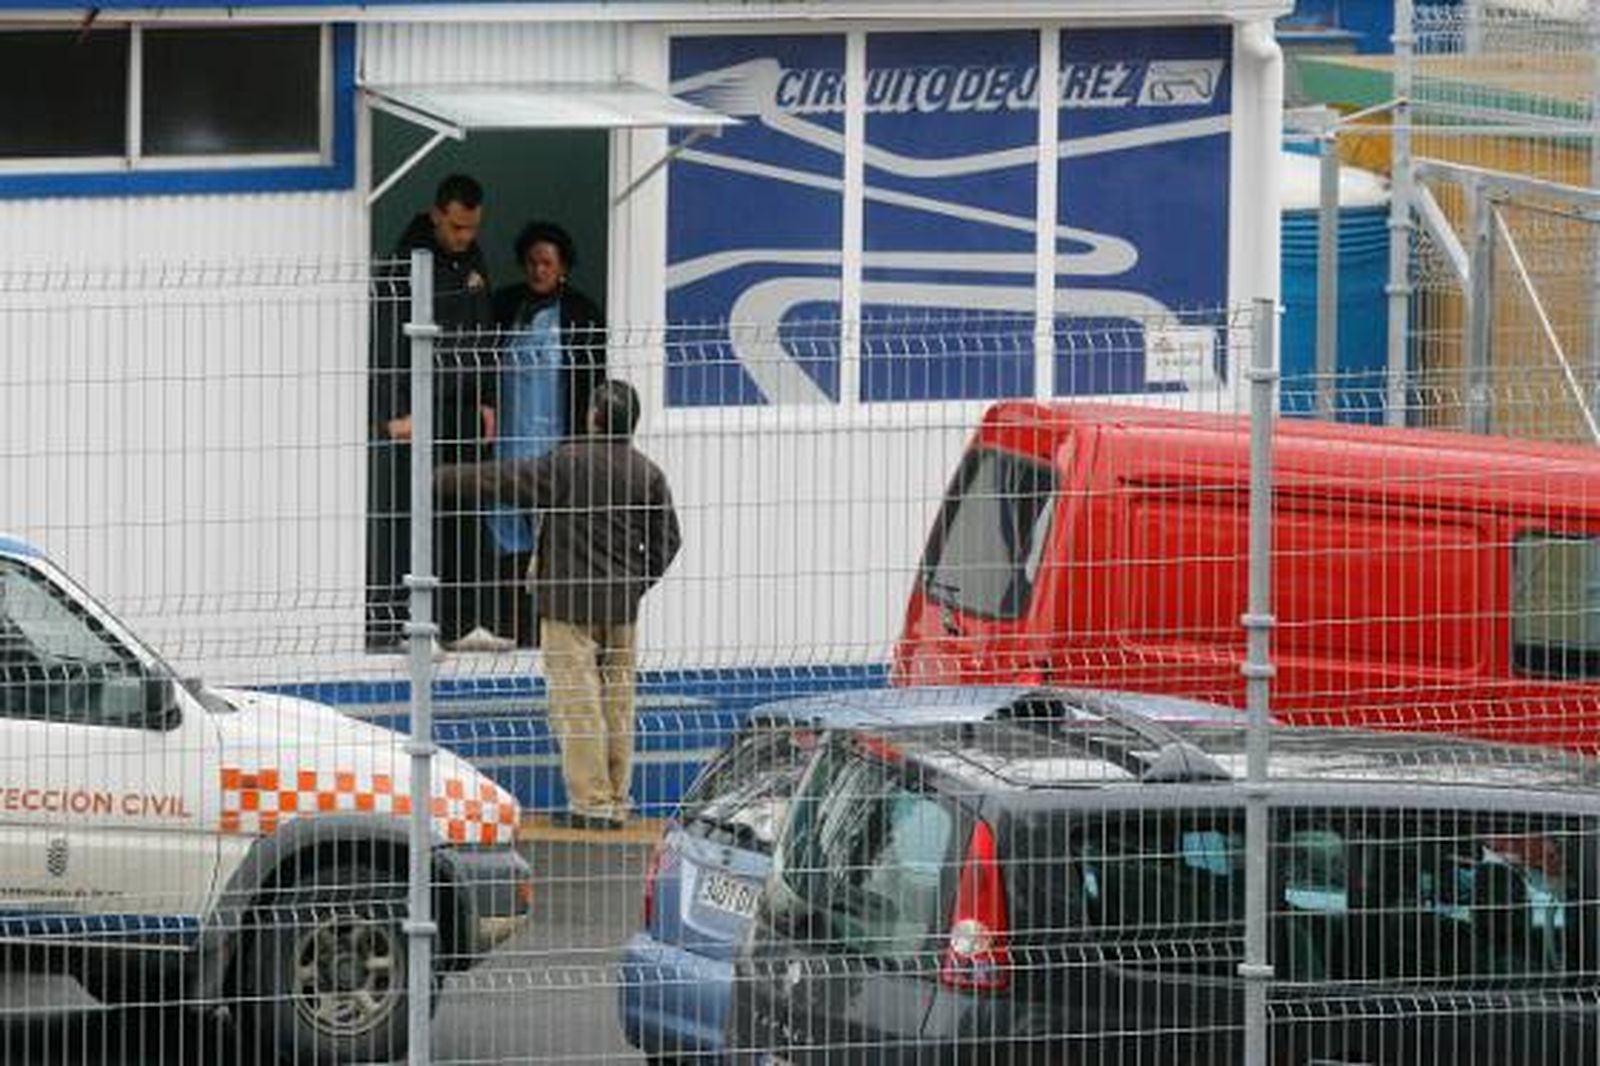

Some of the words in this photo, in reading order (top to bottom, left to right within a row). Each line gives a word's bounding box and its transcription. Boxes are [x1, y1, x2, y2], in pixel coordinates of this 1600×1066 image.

[776, 66, 949, 112] CIRUITO
[950, 66, 1009, 110] DE
[1008, 62, 1138, 107] JREZ
[0, 787, 112, 814] ECCION
[121, 793, 192, 818] CIVIL
